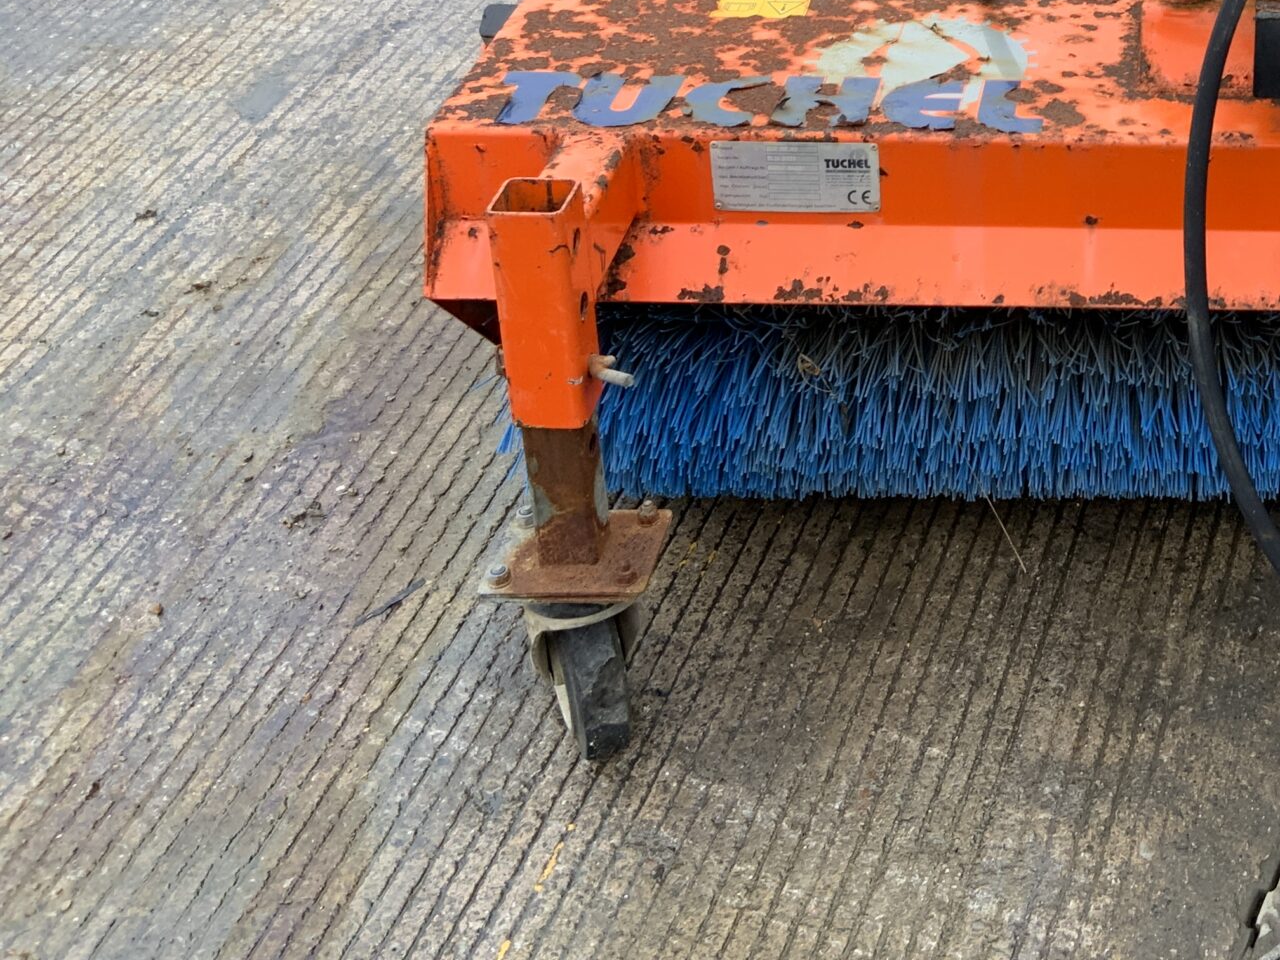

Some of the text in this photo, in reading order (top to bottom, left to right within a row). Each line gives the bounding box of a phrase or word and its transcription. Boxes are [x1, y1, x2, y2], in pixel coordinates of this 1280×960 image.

[496, 70, 1043, 133] TUCHEL
[824, 158, 871, 169] TUCHEL
[847, 190, 872, 205] CE
